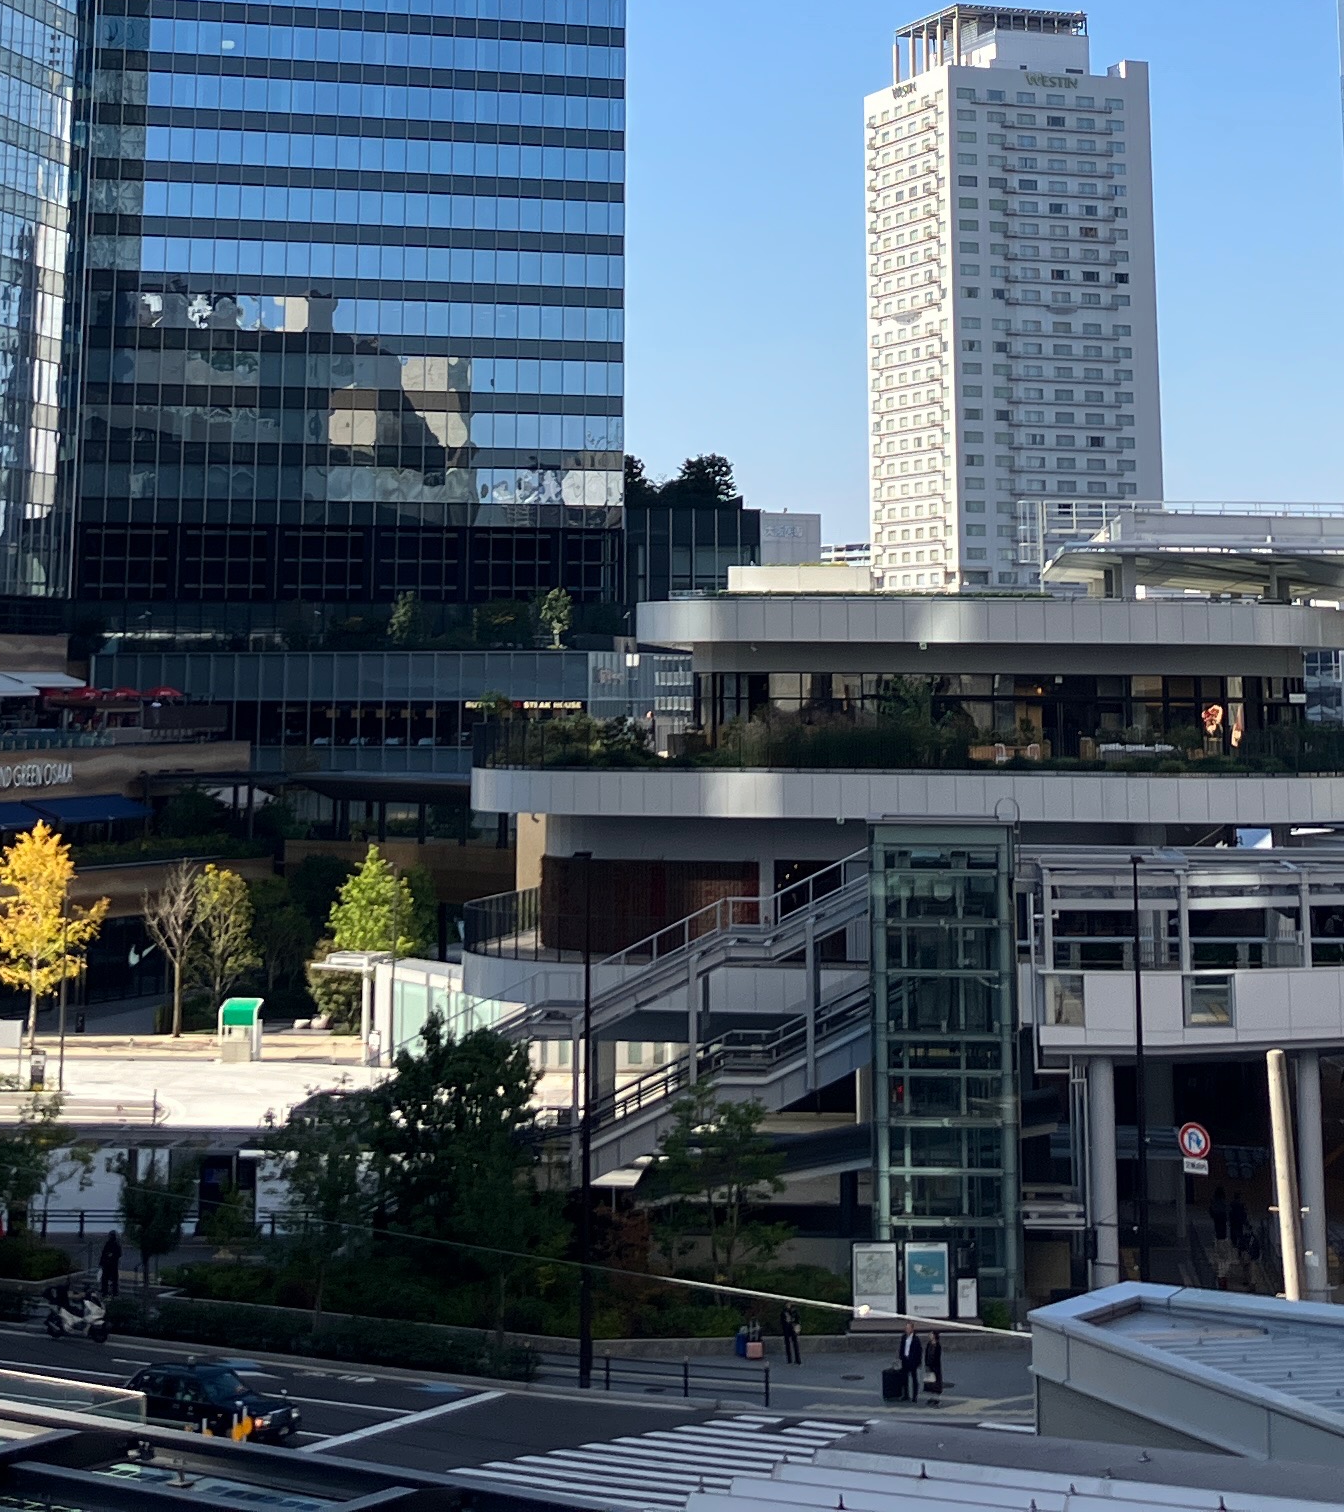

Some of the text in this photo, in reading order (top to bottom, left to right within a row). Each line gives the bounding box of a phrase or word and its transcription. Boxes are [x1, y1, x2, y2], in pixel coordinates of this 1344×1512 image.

[1024, 71, 1078, 90] WESTIN
[891, 81, 917, 100] WESTIN
[12, 764, 43, 788] GREEN
[43, 762, 73, 785] OSAKA
